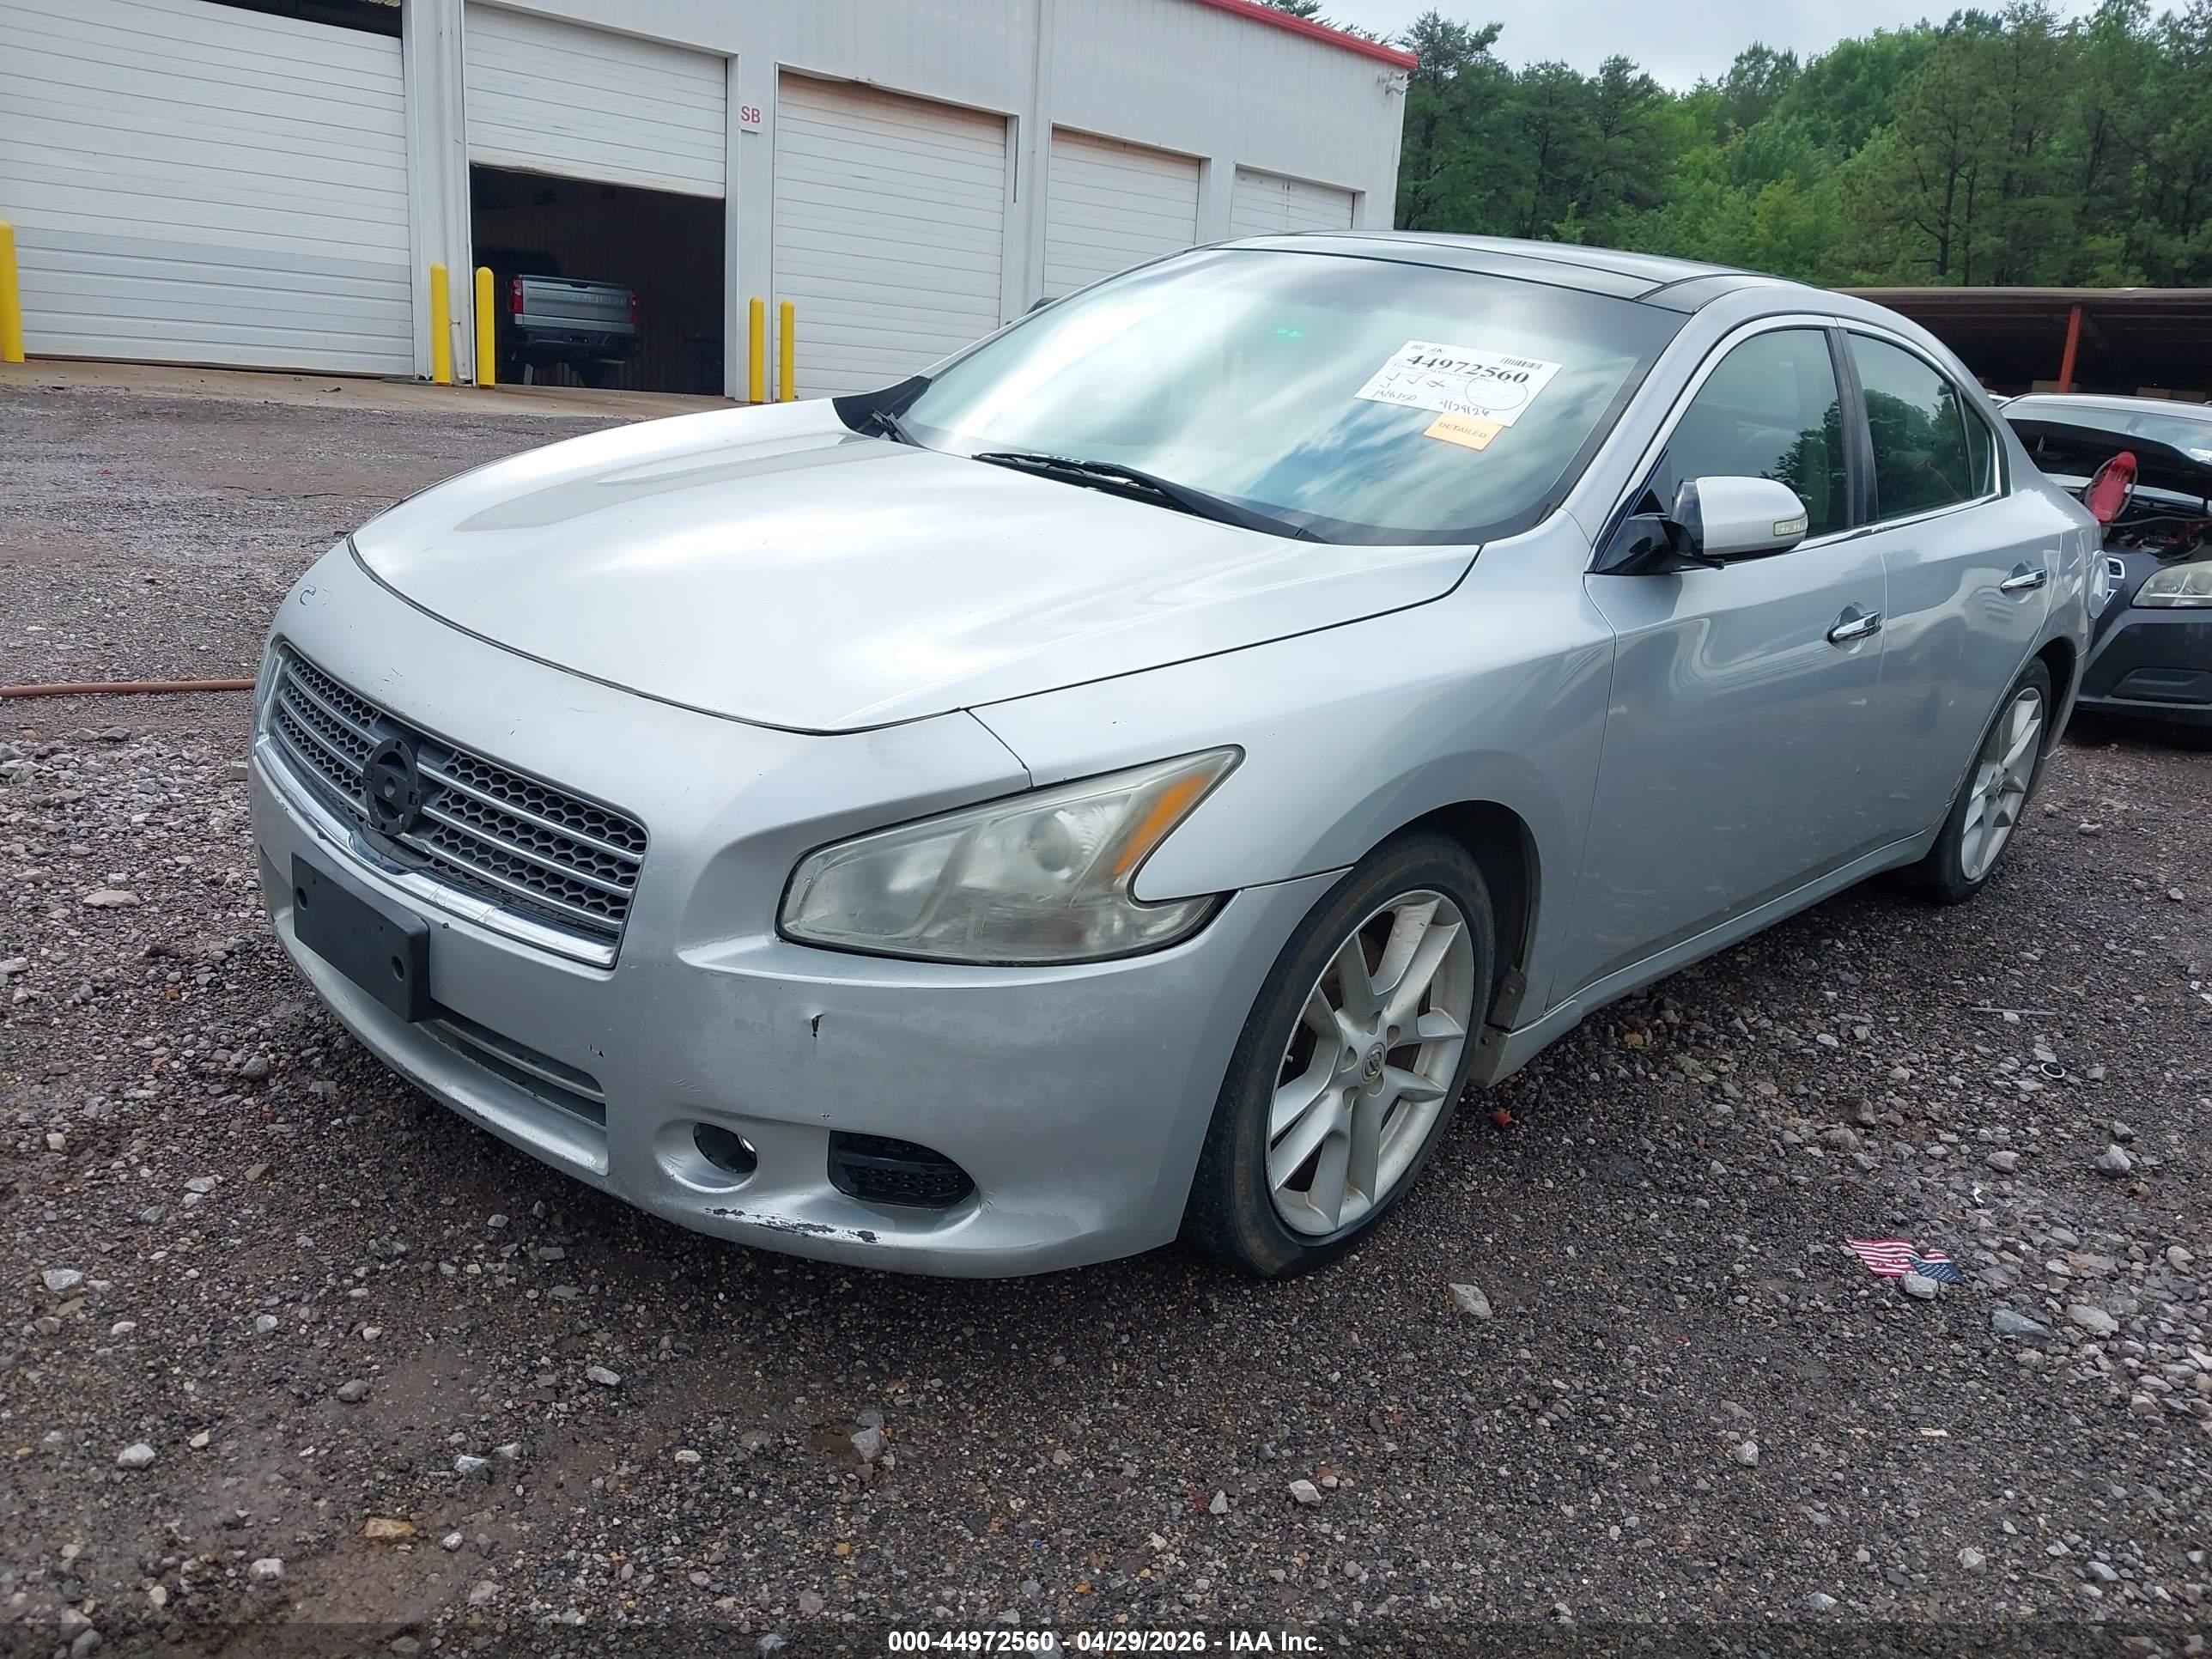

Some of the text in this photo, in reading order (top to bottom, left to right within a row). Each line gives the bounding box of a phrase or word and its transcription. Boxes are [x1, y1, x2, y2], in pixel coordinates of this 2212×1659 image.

[741, 106, 761, 124] SB
[1406, 355, 1529, 384] 44972560
[1438, 422, 1487, 439] DETAILED
